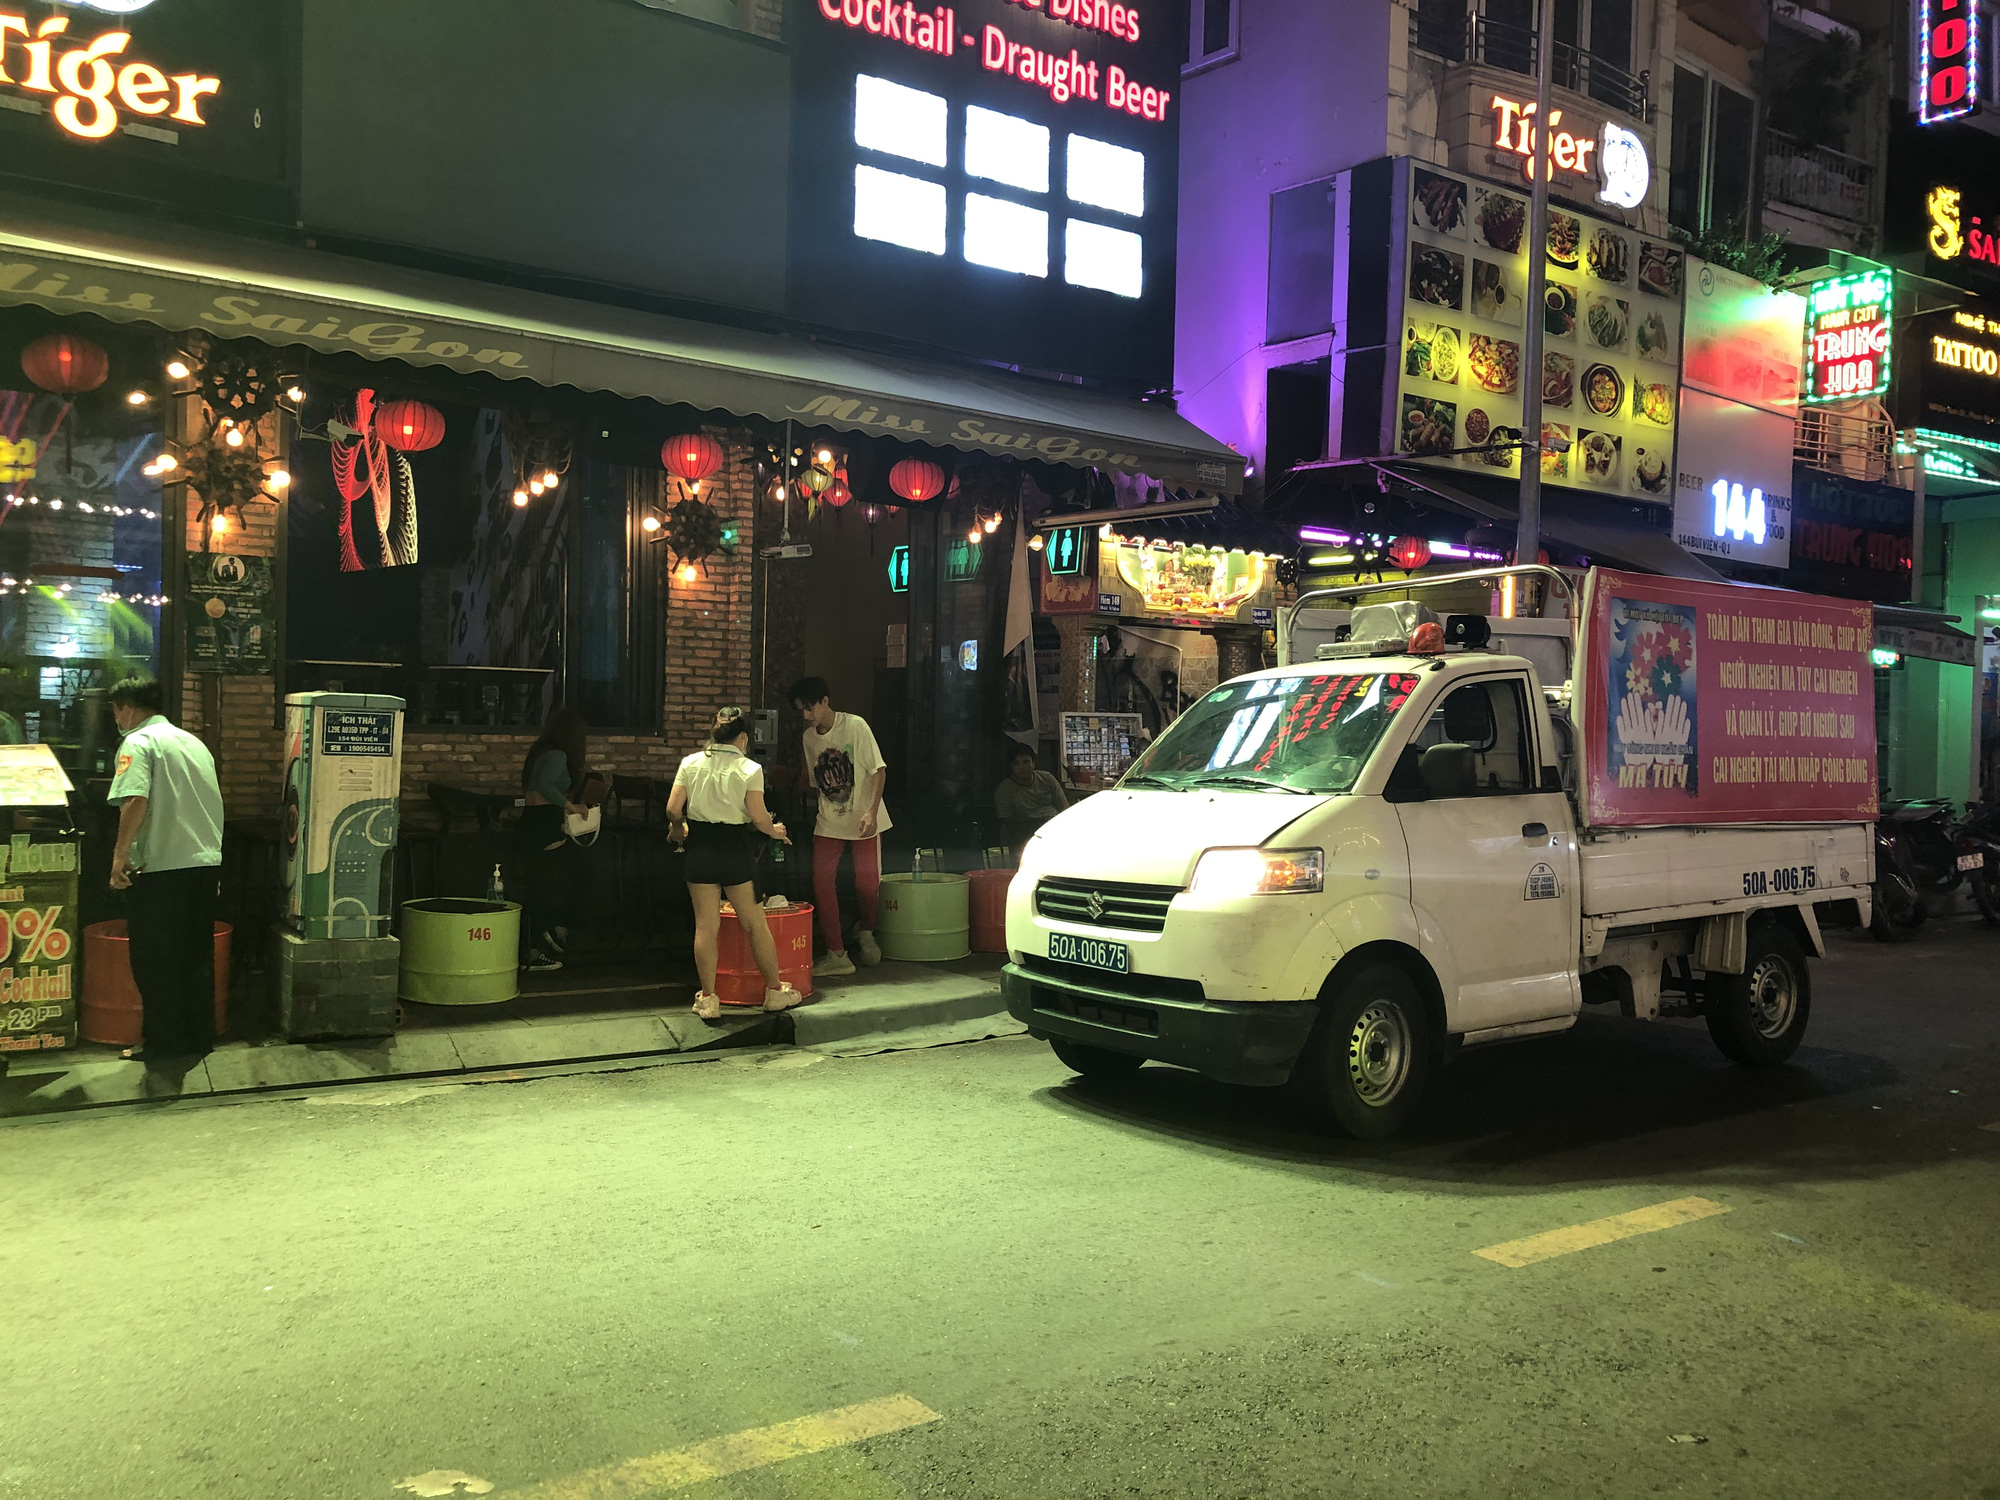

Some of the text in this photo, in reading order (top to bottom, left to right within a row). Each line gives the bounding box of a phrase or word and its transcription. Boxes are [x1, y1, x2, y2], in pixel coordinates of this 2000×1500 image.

[982, 24, 1099, 103] Draught
[1106, 64, 1170, 121] Beer
[200, 296, 529, 370] SaiGon
[1820, 305, 1879, 330] HAIR CUT
[1814, 321, 1887, 363] TRUNG
[1933, 335, 1998, 376] TATTOO
[1823, 359, 1873, 393] HOA
[785, 394, 1142, 468] Miss SaiGon
[1679, 473, 1704, 492] BEER
[1712, 479, 1767, 545] 144
[1770, 509, 1778, 523] &
[1706, 608, 1730, 641] TOÀN
[1731, 610, 1750, 642] DÂN
[1751, 617, 1776, 645] THAM
[1777, 619, 1791, 646] GIA
[1792, 616, 1810, 653] VẬN
[1837, 622, 1856, 651] GIÚP
[1748, 659, 1780, 697] NGHIỆN
[1781, 666, 1795, 691] MA
[1797, 661, 1813, 692] TÚY
[1813, 667, 1828, 694] CAI
[1725, 704, 1737, 736] VÀ
[1778, 705, 1798, 737] GIÚP
[1813, 707, 1838, 739] NGƯỜI
[1839, 714, 1855, 740] SAU
[1619, 763, 1648, 789] MA
[1713, 750, 1868, 789] CAI NGHIỆN TÁI HÒA NHẬP CỘNG ĐỒNG
[1743, 865, 1816, 896] 50A-006.75
[885, 900, 899, 912] 144
[467, 927, 492, 942] 146
[791, 934, 807, 952] 145
